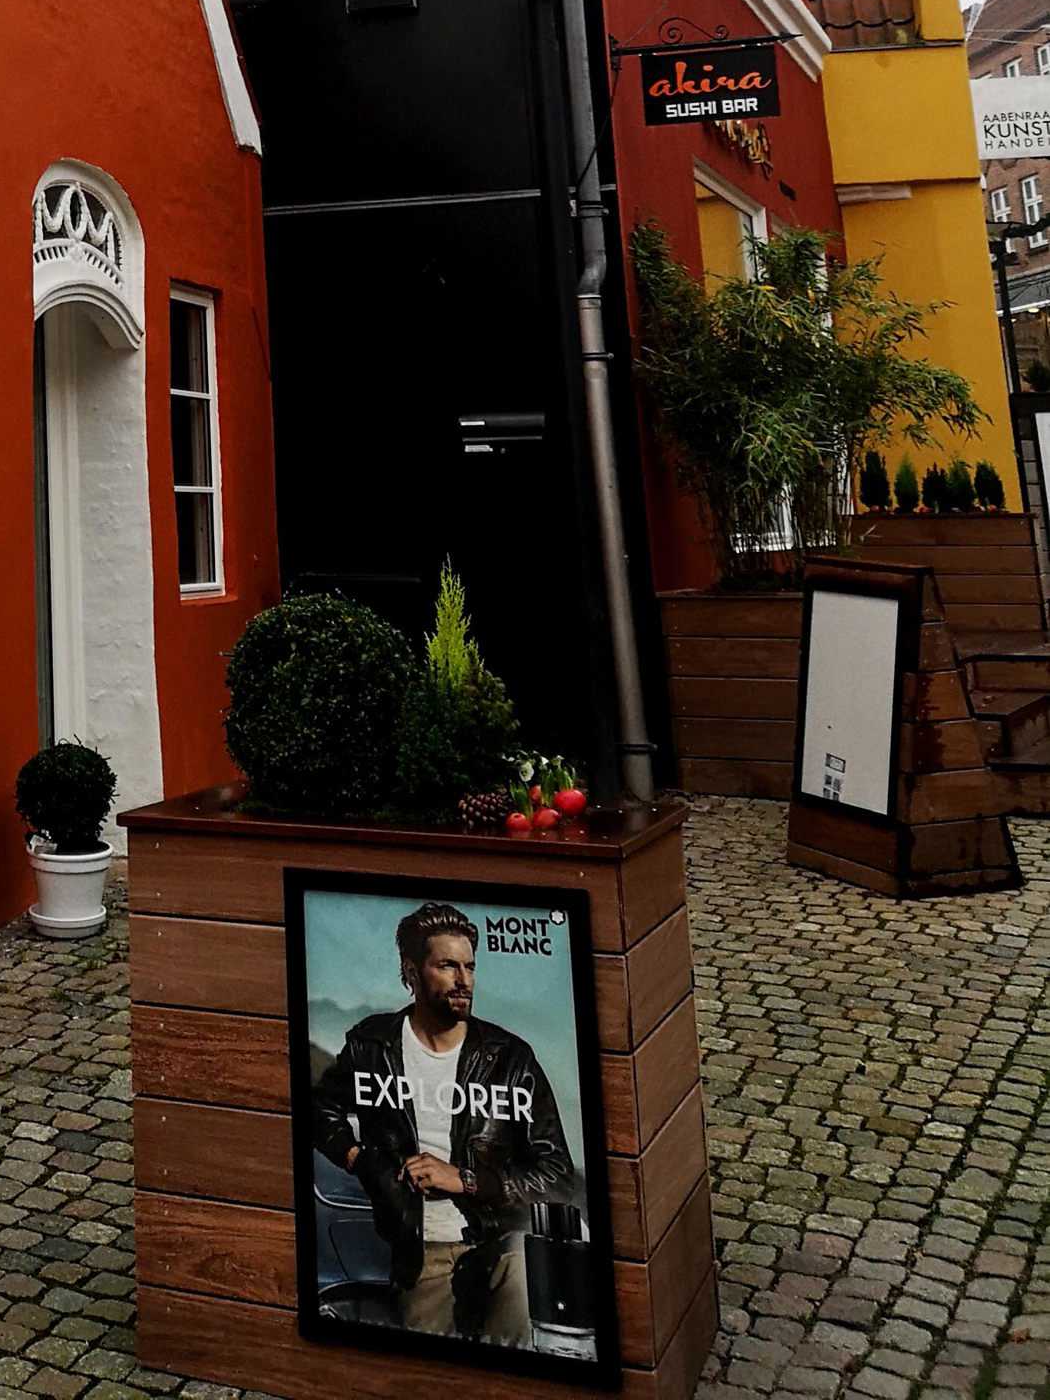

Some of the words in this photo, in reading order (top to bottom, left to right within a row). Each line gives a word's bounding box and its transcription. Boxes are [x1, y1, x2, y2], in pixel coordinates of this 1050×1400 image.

[649, 61, 772, 97] akira
[665, 101, 717, 118] SUSHI
[722, 97, 759, 114] BAR
[982, 111, 1050, 123] AABENRAA
[983, 120, 1050, 139] KUNST
[486, 915, 550, 937] MONT
[486, 935, 553, 956] BLANC
[353, 1071, 535, 1123] EXPLORER
